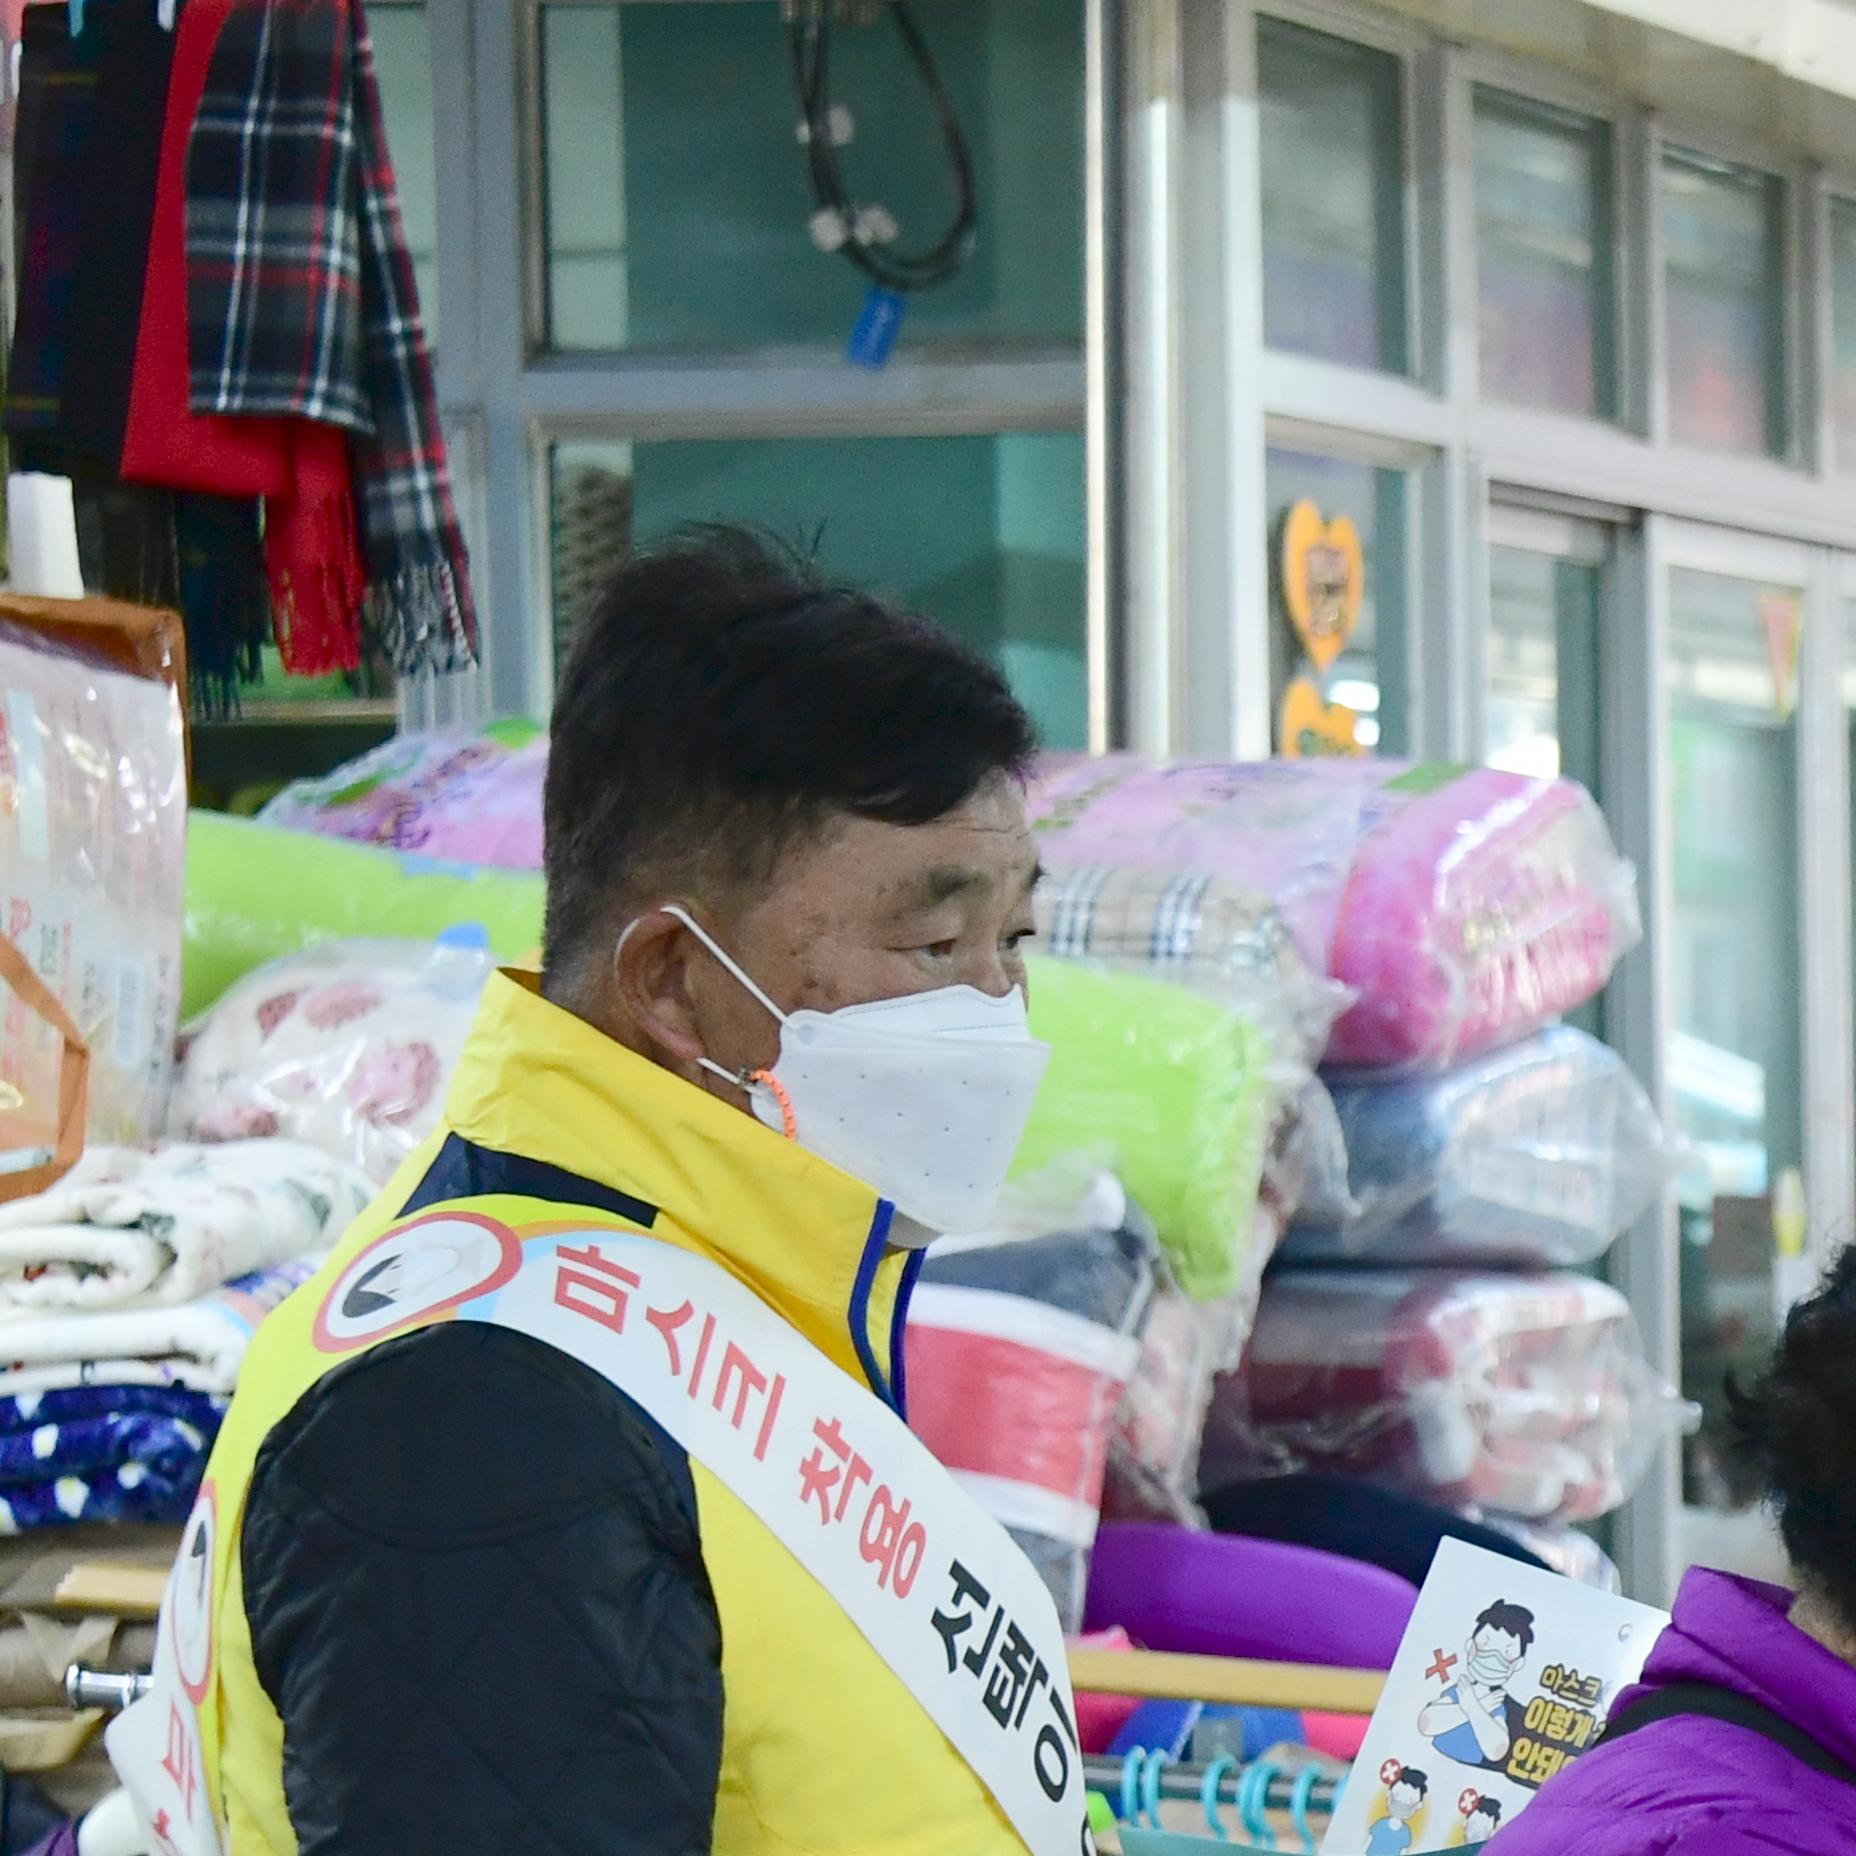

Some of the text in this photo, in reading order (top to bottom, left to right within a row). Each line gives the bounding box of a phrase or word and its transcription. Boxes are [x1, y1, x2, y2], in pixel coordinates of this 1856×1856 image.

[553, 1242, 1076, 1804] 마스크 착용 선택이
[1540, 1663, 1603, 1708] 마스크
[1523, 1695, 1597, 1749] 이렇게
[1506, 1736, 1577, 1784] 안돼
